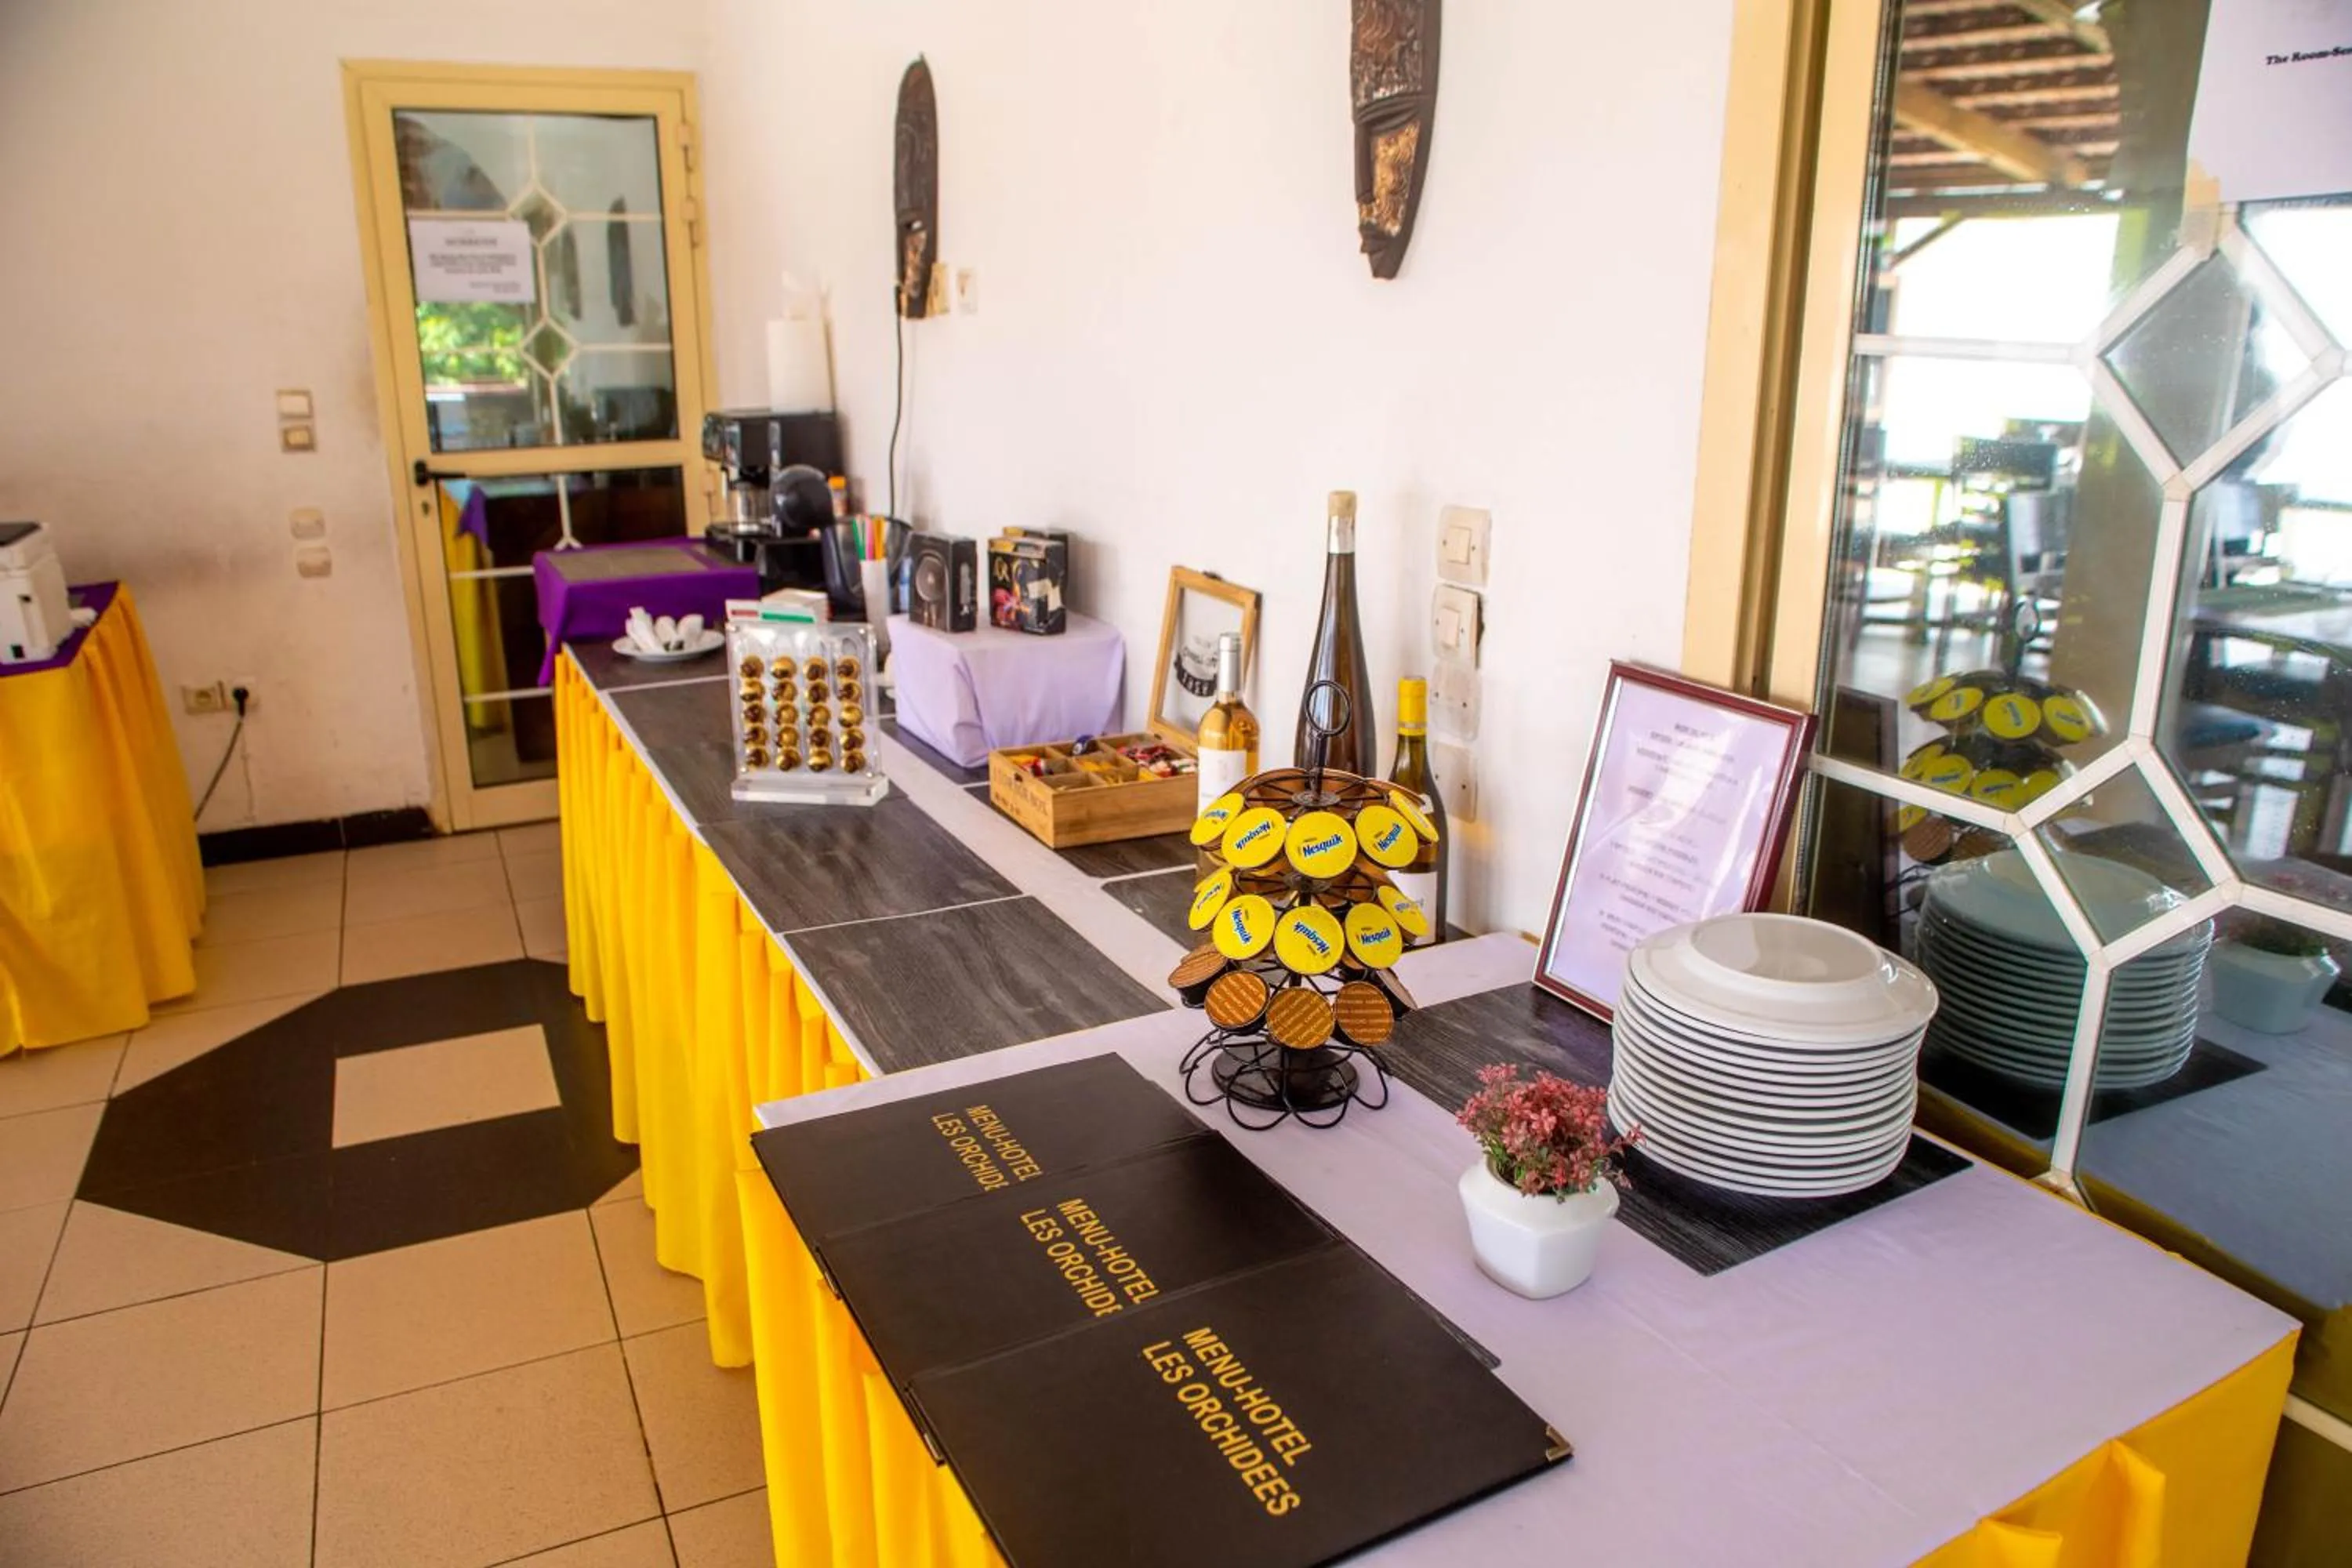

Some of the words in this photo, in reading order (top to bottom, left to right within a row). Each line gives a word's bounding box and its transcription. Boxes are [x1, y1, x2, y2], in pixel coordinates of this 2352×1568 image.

[1234, 820, 1271, 851] Nesquik
[1302, 833, 1343, 857] Nesquik
[1377, 822, 1402, 851] Nesquik
[1232, 908, 1252, 943] Nesquik
[1293, 921, 1330, 953] Nesquik
[1360, 927, 1392, 945] Nesquik
[931, 1112, 967, 1137] LES
[965, 1104, 1044, 1181] MENU-HOTEL
[1020, 1208, 1065, 1243] LES
[1057, 1197, 1161, 1305] MENU-HOTEL
[1181, 1326, 1312, 1468] MENU-HOTEL
[1142, 1340, 1195, 1385] LES
[1177, 1381, 1301, 1517] ORCHIDEES
